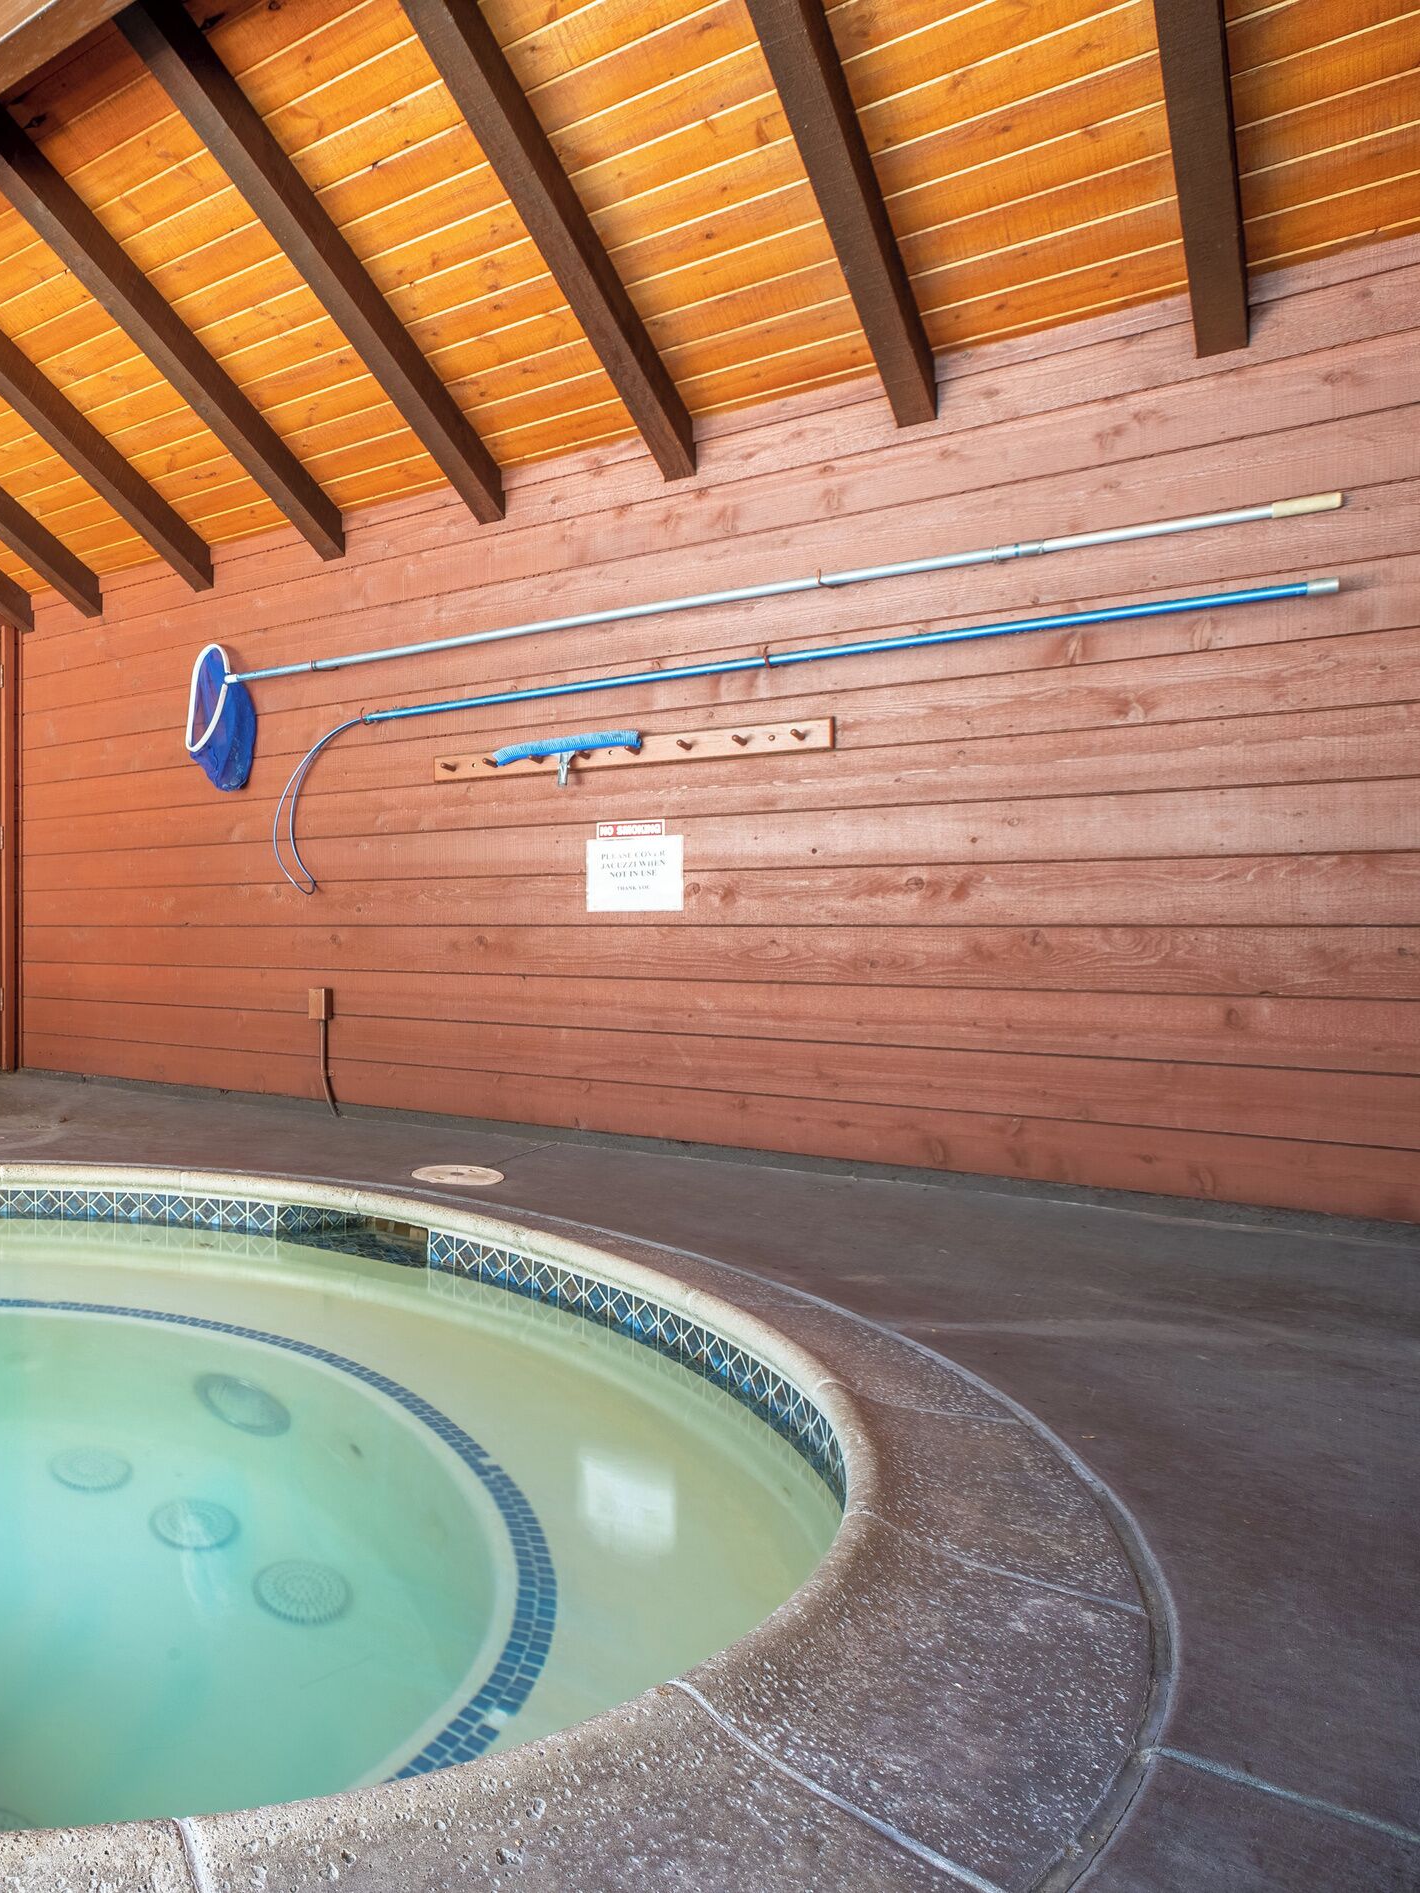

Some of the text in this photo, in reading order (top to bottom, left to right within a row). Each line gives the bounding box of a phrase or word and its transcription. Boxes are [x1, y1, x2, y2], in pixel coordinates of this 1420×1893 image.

[600, 824, 661, 836] NO SMOKING
[602, 850, 666, 860] PLEASE COVER
